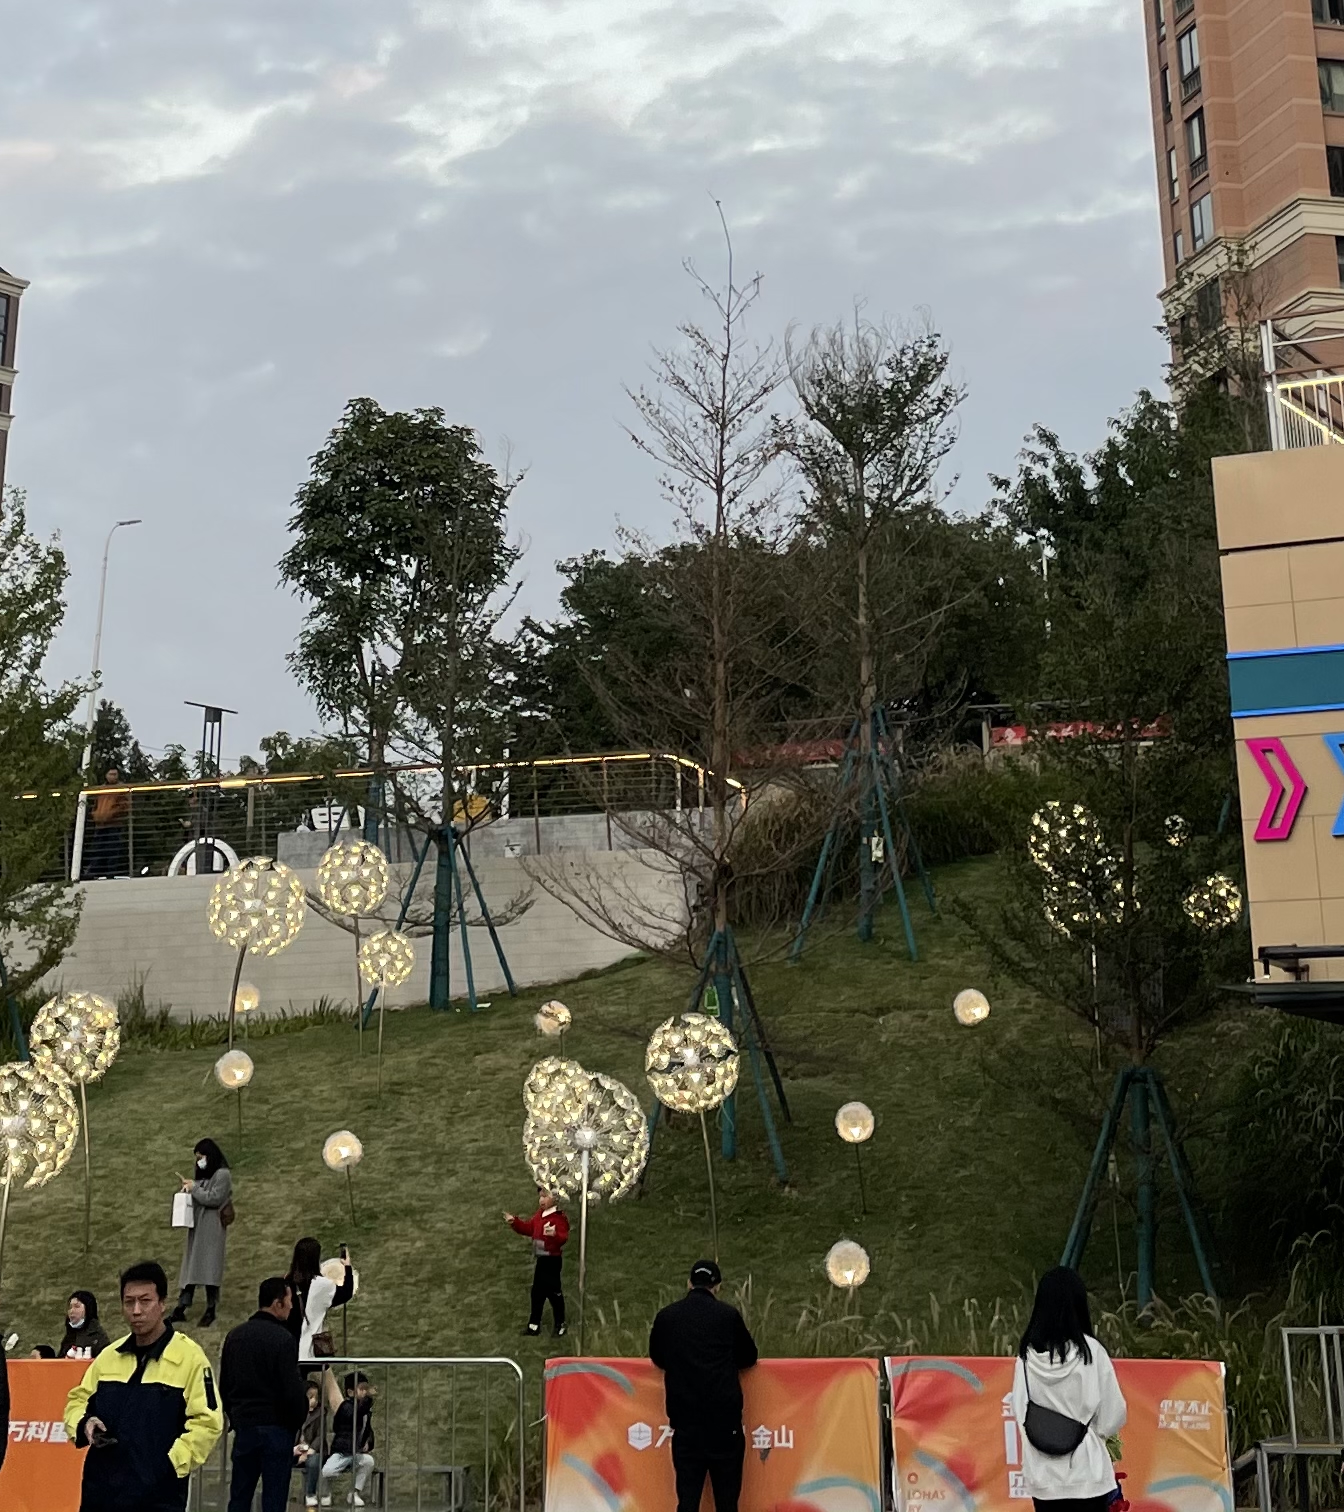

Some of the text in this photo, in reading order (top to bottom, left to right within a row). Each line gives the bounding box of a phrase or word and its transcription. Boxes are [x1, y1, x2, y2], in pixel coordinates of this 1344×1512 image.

[7, 1420, 69, 1443] 万科里
[751, 1424, 794, 1449] 金山
